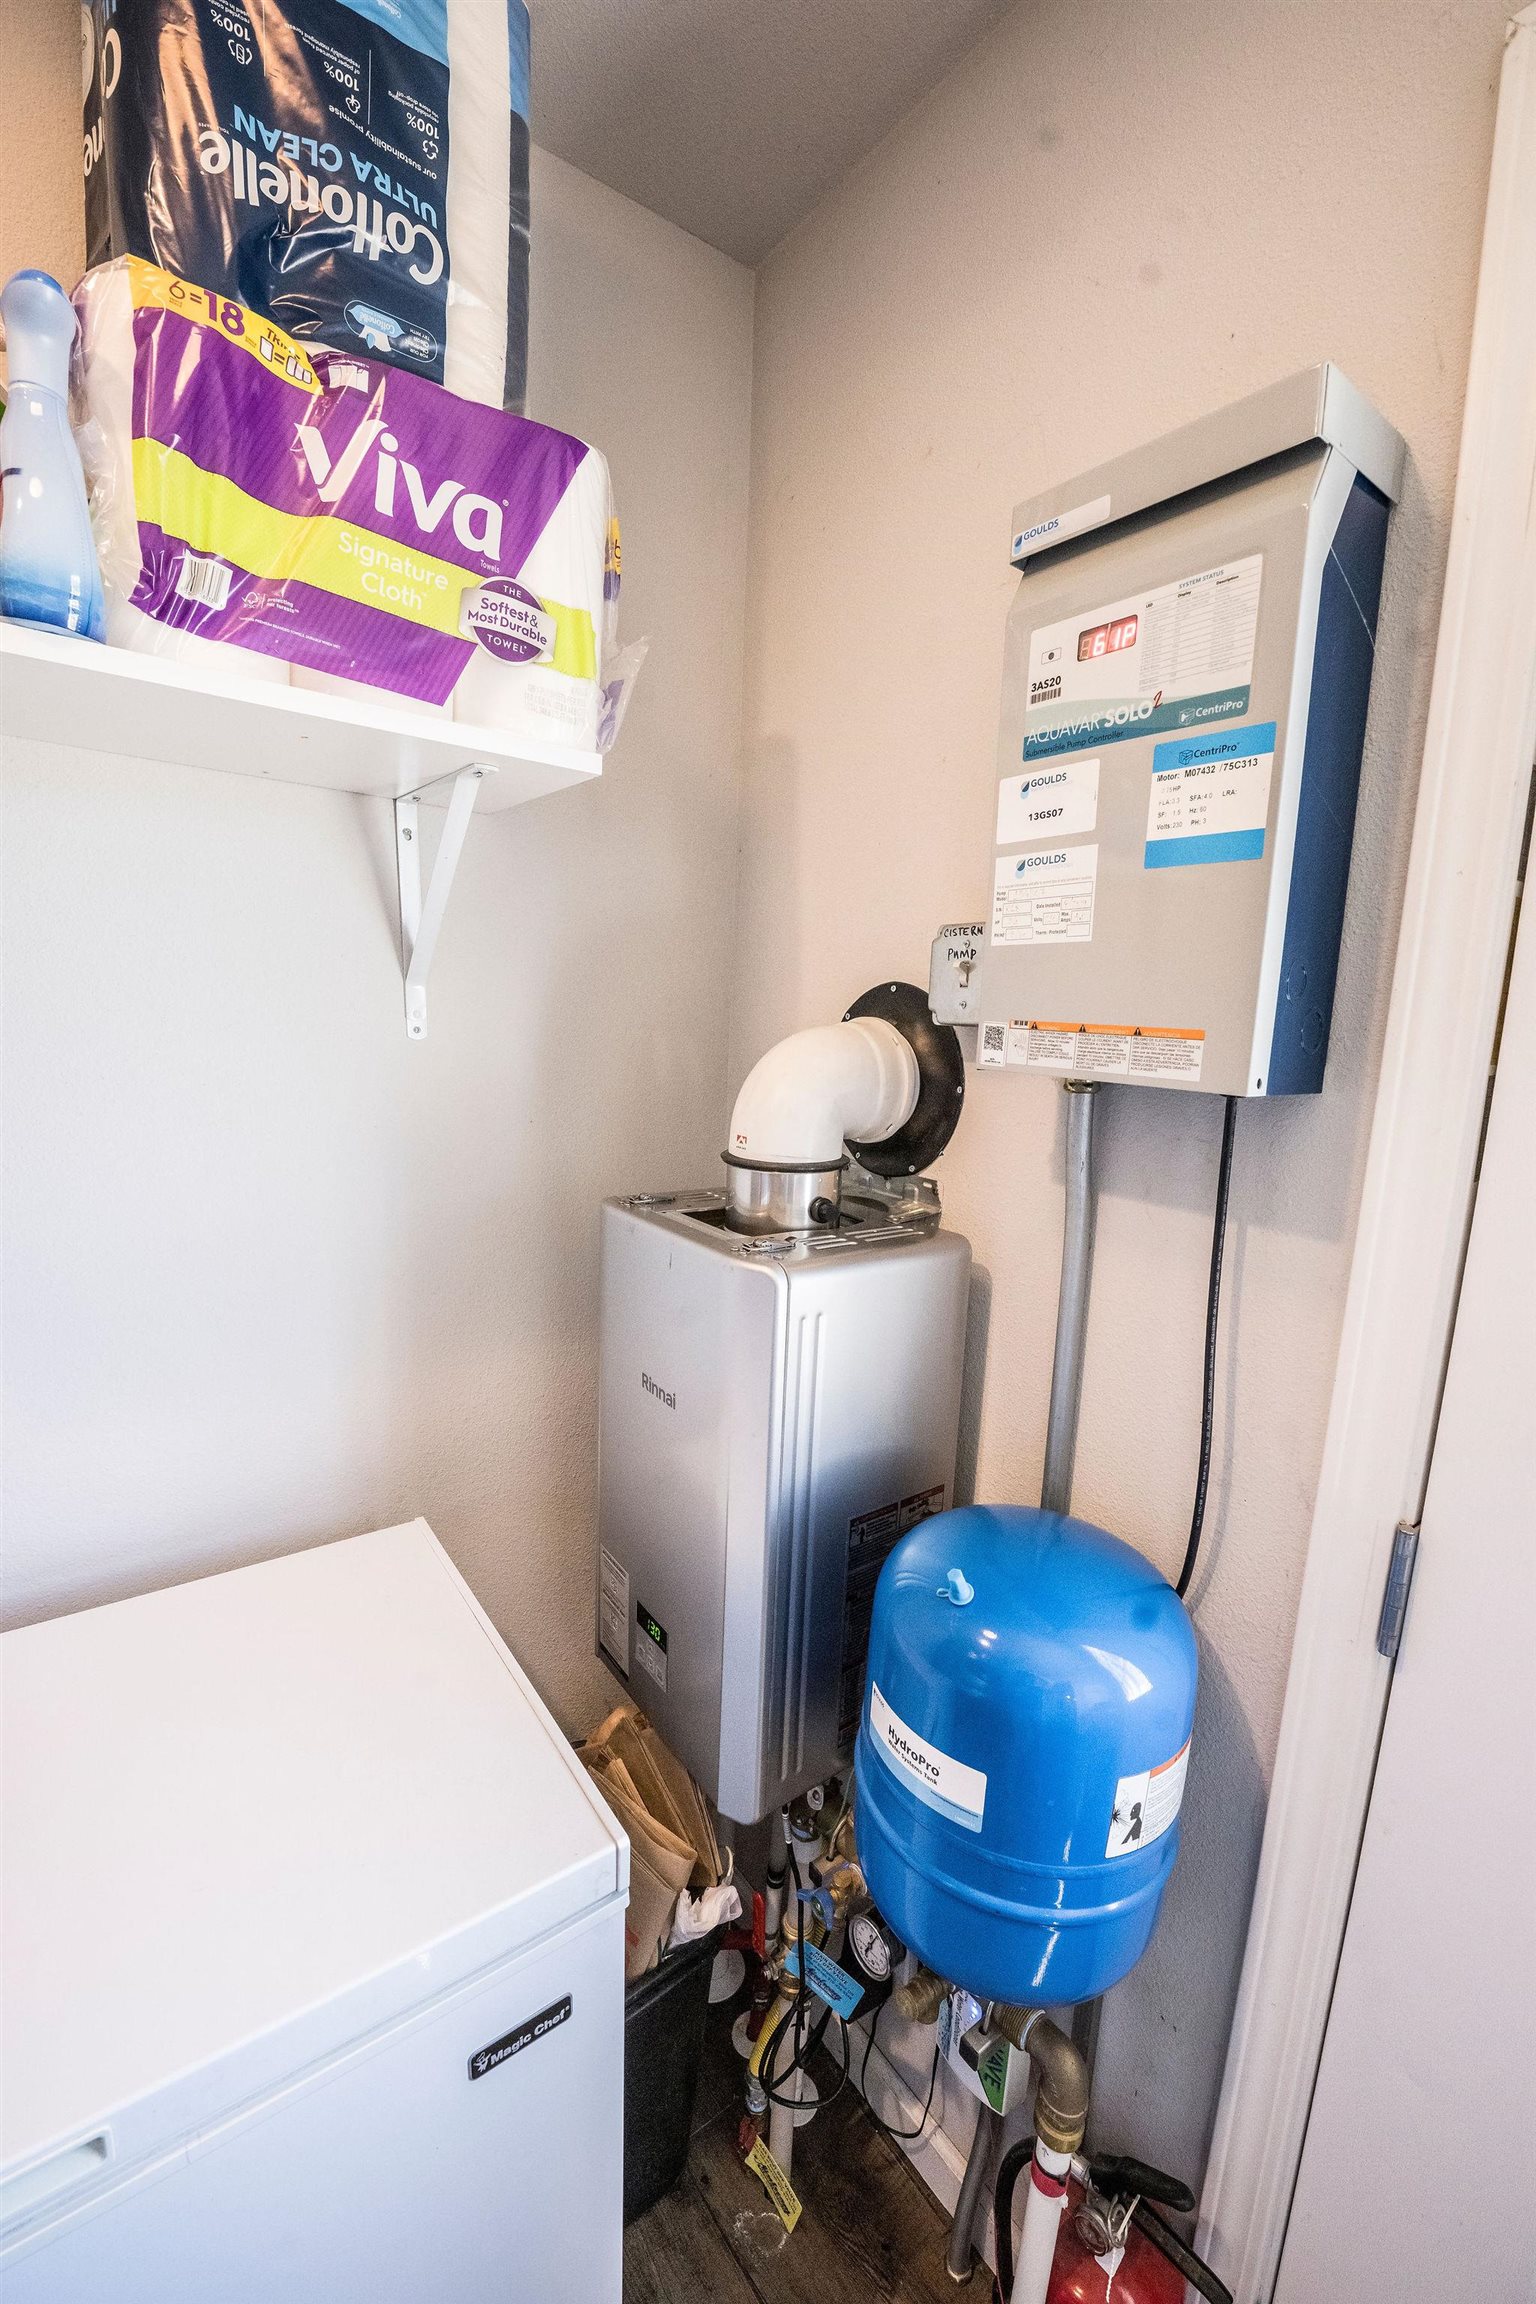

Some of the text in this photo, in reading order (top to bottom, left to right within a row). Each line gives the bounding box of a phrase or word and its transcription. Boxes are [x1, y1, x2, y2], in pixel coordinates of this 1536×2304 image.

[210, 9, 250, 41] 100%
[323, 61, 359, 92] 100%
[406, 112, 439, 139] 100%
[328, 104, 437, 180] our sustainability promise
[233, 104, 437, 229] ULTRA CLEAN
[199, 131, 444, 285] Cottonelle
[203, 289, 245, 336] 18
[293, 420, 504, 561] Viva
[1023, 518, 1059, 540] GOULDS
[338, 531, 449, 590] Signature
[480, 559, 500, 574] Towels
[361, 571, 423, 611] Cloth
[503, 585, 522, 599] THE
[1179, 569, 1225, 590] SYSTEM STATUS
[481, 598, 529, 623] Softest
[468, 610, 548, 646] Most Durable
[1031, 676, 1062, 693] 3AS20
[1195, 700, 1244, 718] CentriPro
[1026, 712, 1100, 746] AQUAVAR
[1103, 700, 1154, 728] SOLO
[1025, 731, 1124, 758] Submersible Pump Controller
[1194, 744, 1238, 758] CentriPro
[1031, 772, 1067, 788] GOULDS
[1156, 774, 1180, 782] Motor:
[1184, 765, 1216, 778] M07432
[1028, 808, 1064, 821] 13GS07
[1027, 854, 1067, 868] GOULDS
[944, 925, 984, 938] CISTERN
[947, 948, 977, 961] PUMP
[642, 1372, 676, 1410] Rinnai
[647, 1619, 660, 1641] 130
[887, 1738, 938, 1786] Water Systems Tank
[888, 1725, 940, 1777] HydroPro
[490, 2008, 566, 2066] Magic Chef
